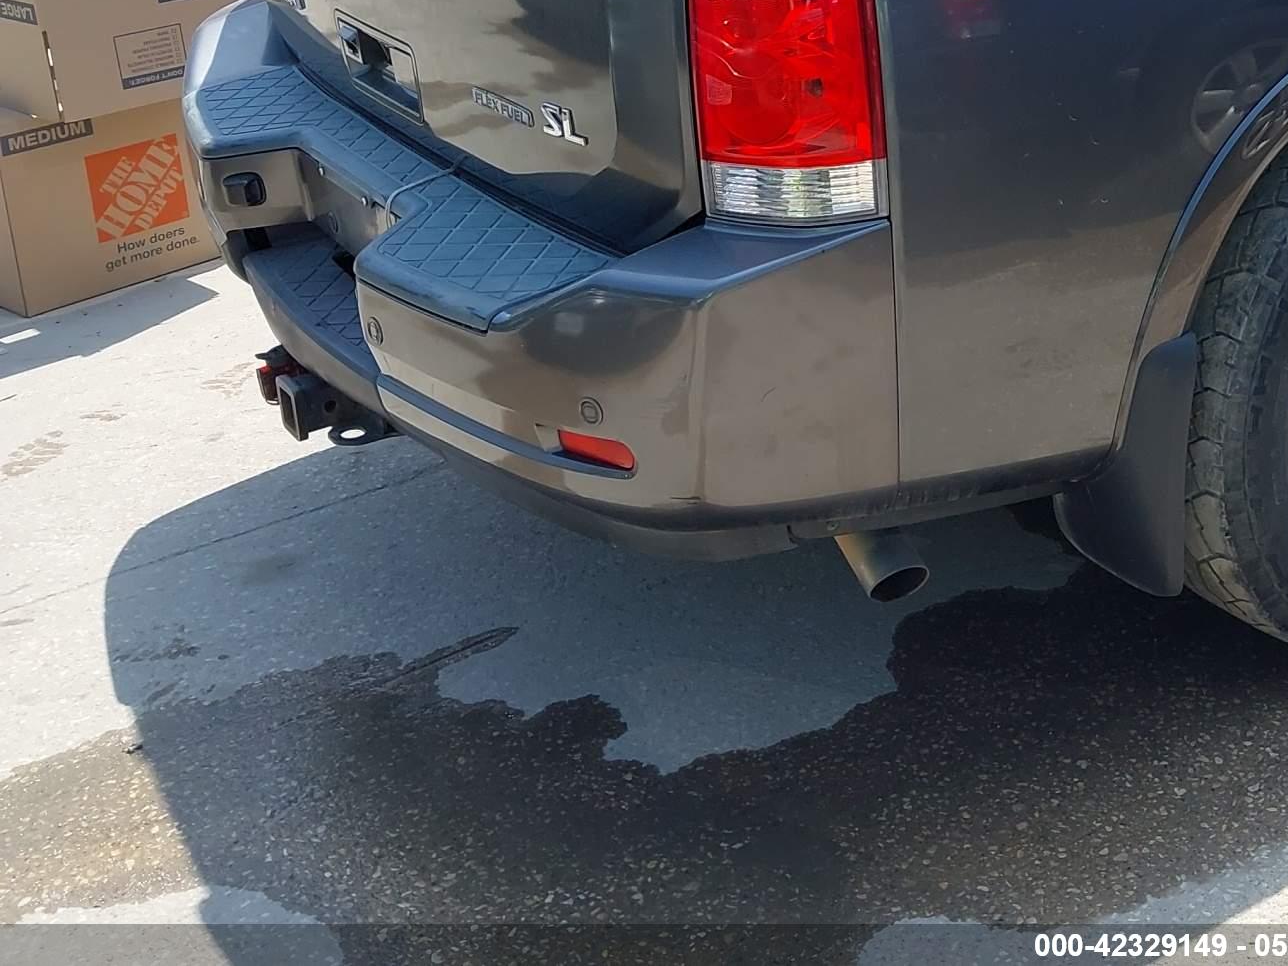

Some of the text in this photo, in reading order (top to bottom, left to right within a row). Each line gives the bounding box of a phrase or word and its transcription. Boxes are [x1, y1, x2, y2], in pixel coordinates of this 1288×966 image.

[474, 89, 528, 126] FLEX FUEL
[540, 100, 588, 146] SL
[7, 120, 86, 152] MEDIUM
[95, 137, 177, 237] HOME
[99, 155, 136, 195] THE
[134, 165, 185, 230] DEPOT
[105, 234, 200, 273] get more done.
[117, 225, 186, 254] How doers
